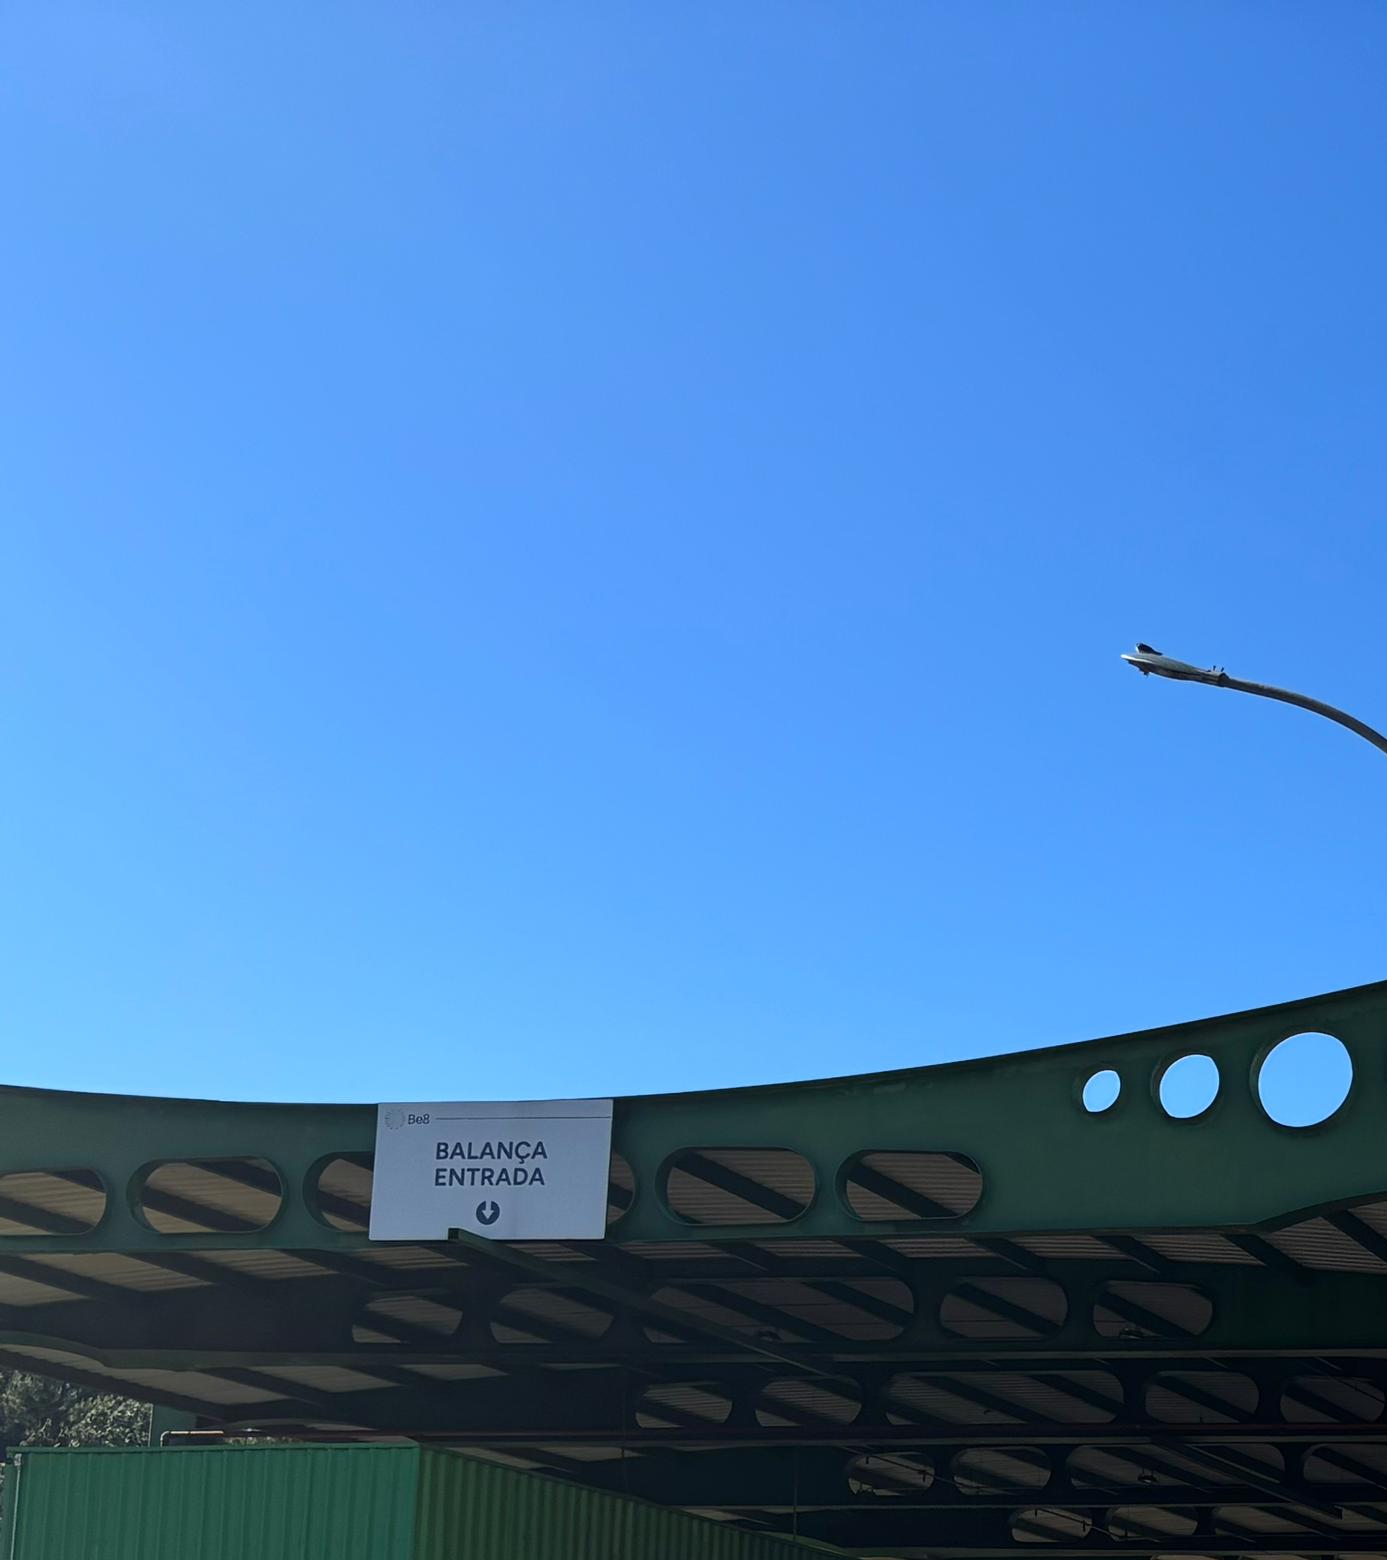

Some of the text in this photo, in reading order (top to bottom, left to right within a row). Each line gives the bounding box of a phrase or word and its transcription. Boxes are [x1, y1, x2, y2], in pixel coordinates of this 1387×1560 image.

[408, 1113, 430, 1125] Be8
[435, 1141, 548, 1164] BALANÇA
[434, 1167, 545, 1187] ENTRADA
